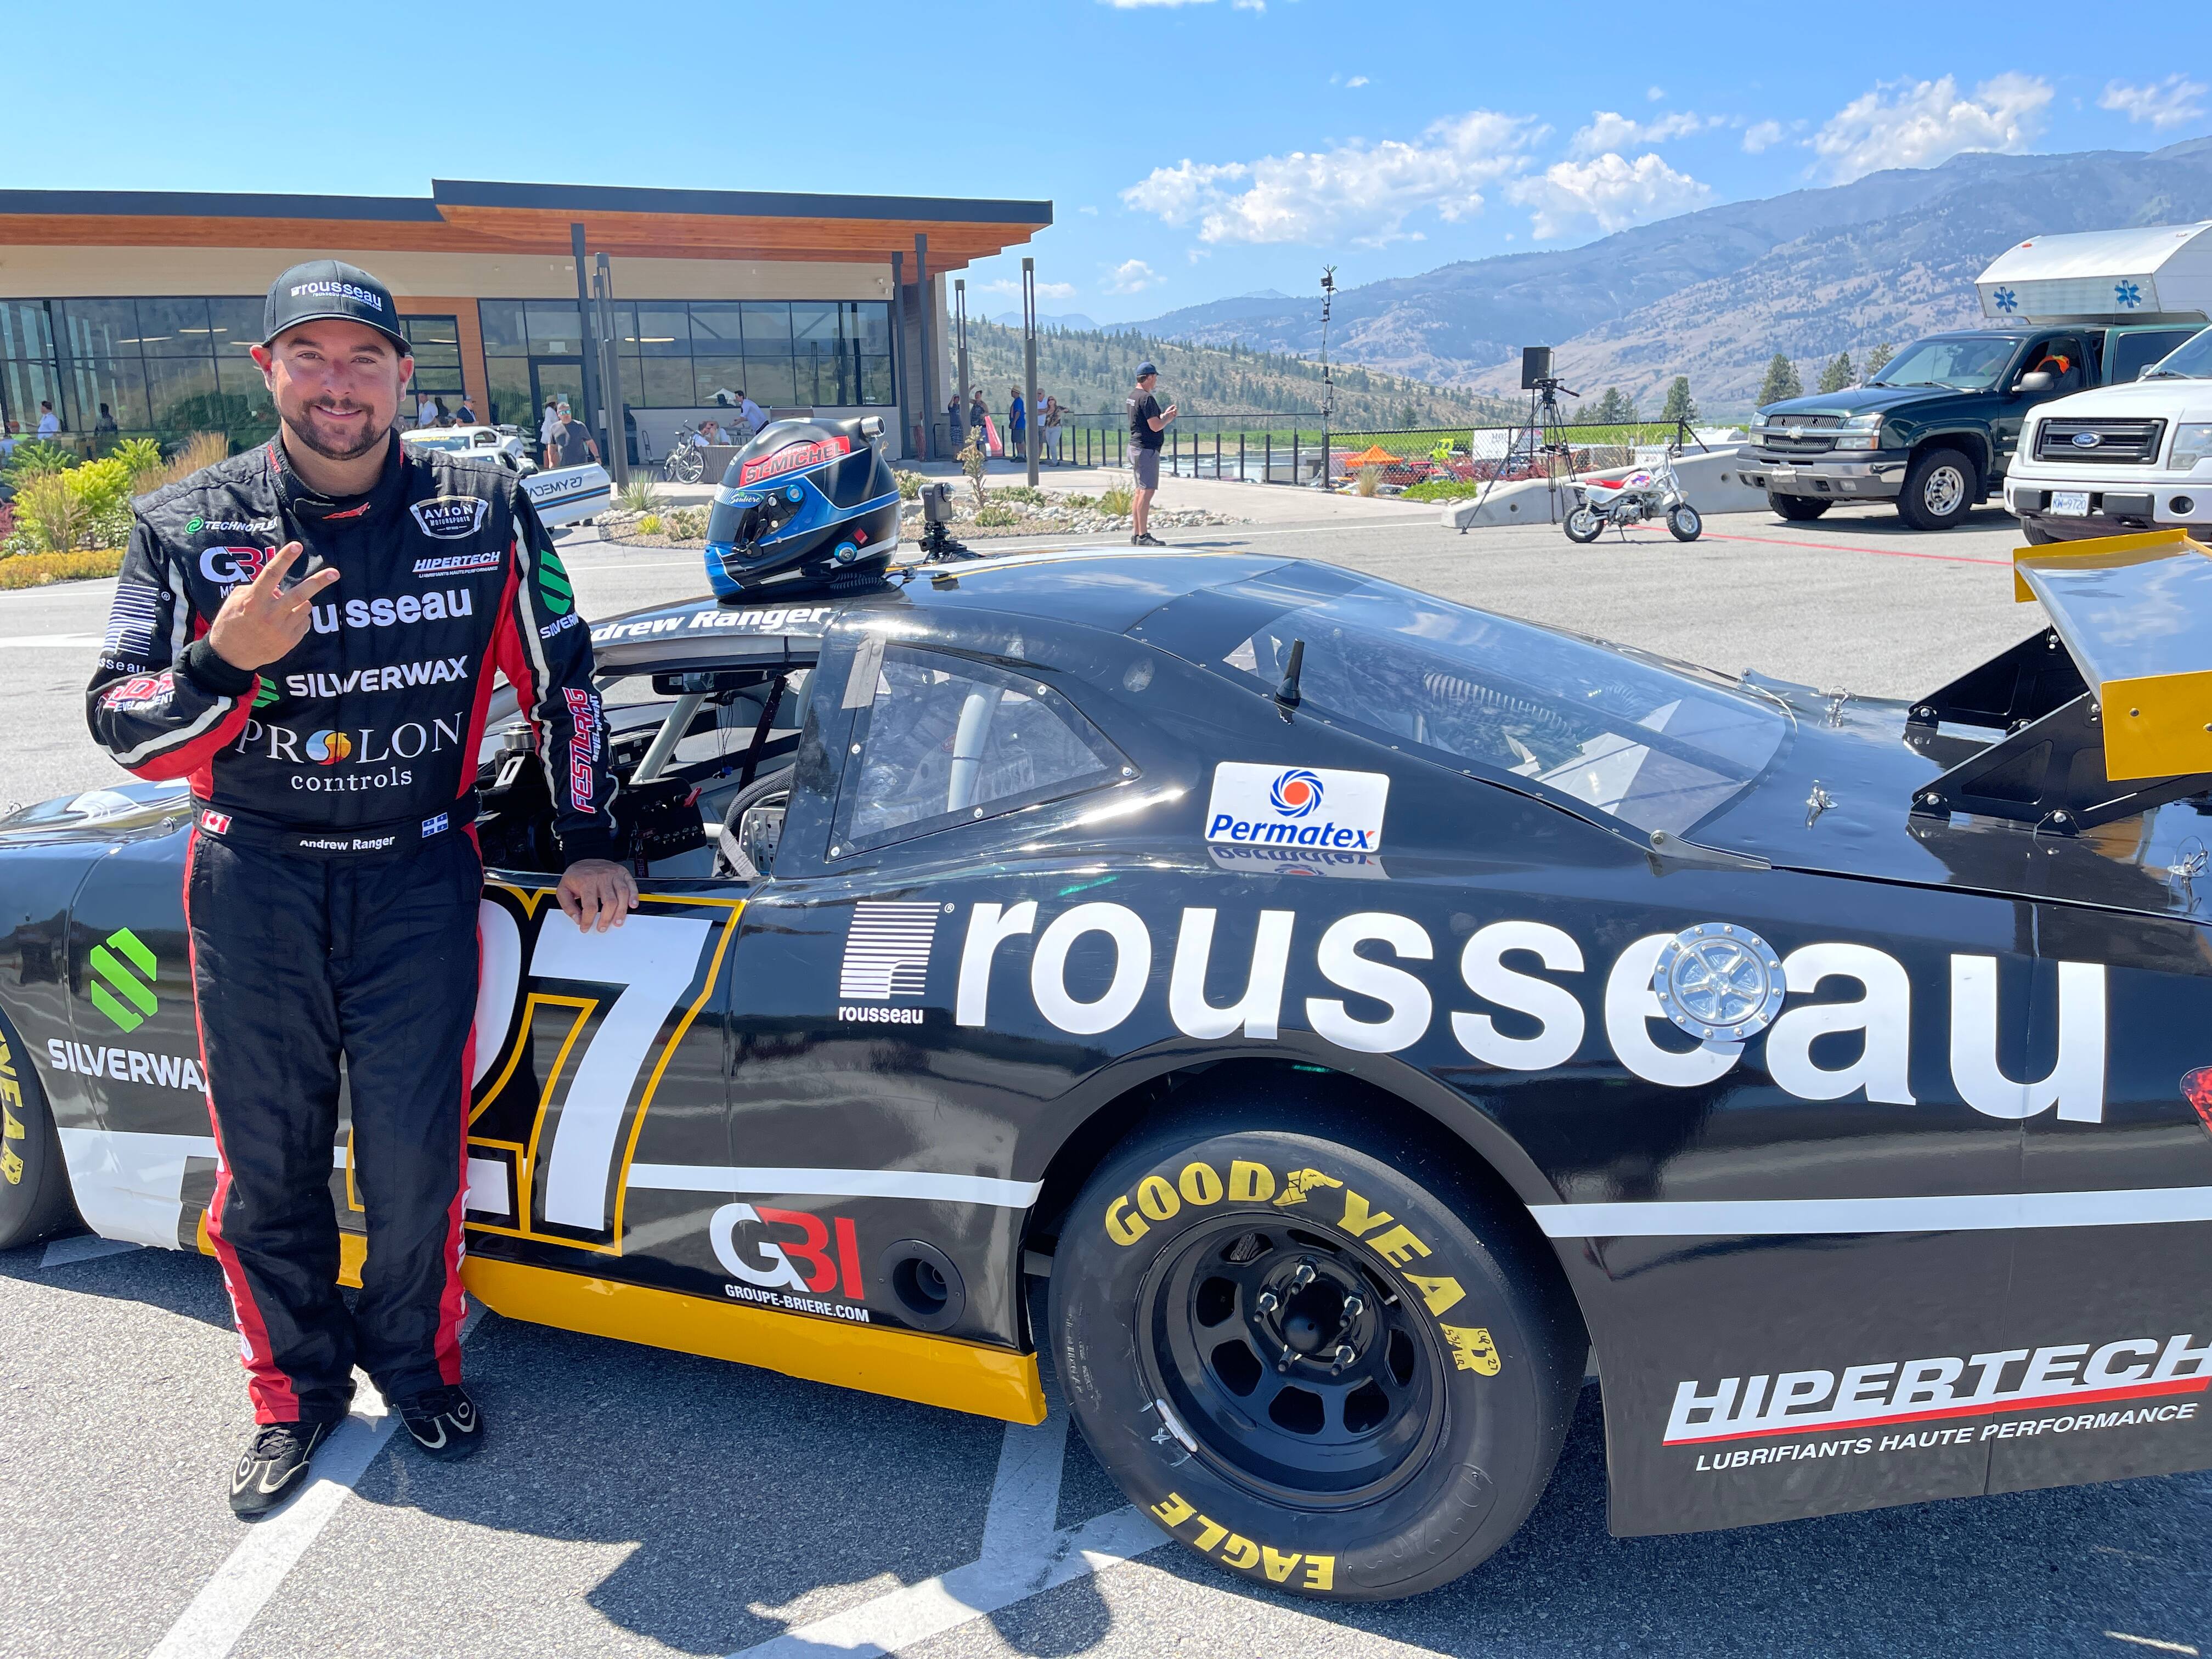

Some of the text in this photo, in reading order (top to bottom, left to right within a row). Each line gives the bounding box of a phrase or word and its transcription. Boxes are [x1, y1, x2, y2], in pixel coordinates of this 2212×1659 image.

[301, 281, 382, 308] rousseau
[746, 443, 844, 483] ST-MICHEL
[768, 445, 812, 459] TANSPORT
[425, 504, 473, 520] AVION
[430, 516, 471, 527] MOTORSPORTS
[413, 551, 501, 572] HIPERTECH
[312, 588, 473, 635] usseau
[539, 612, 579, 639] SILVER
[589, 607, 832, 641] drew Ranger
[99, 658, 146, 674] sseau
[286, 655, 468, 698] SILVERWAX
[235, 712, 463, 766] PROLON
[589, 693, 602, 763] DEVELPMENT
[291, 766, 413, 792] controls
[300, 836, 396, 850] Andrew Ranger
[1208, 814, 1376, 850] Permatex
[839, 1006, 924, 1024] rousseau
[955, 900, 2107, 1123] rousseau
[47, 1039, 207, 1092] SILVERWA
[710, 1203, 865, 1300] GBI
[725, 1284, 870, 1323] GROUPE-BRIERE.COM
[1663, 1334, 2212, 1441] HIPERTECH
[1696, 1402, 2199, 1472] LUBRIFIANTS HAUTE PERFORMANCE
[1151, 1492, 1336, 1590] EAGLE
